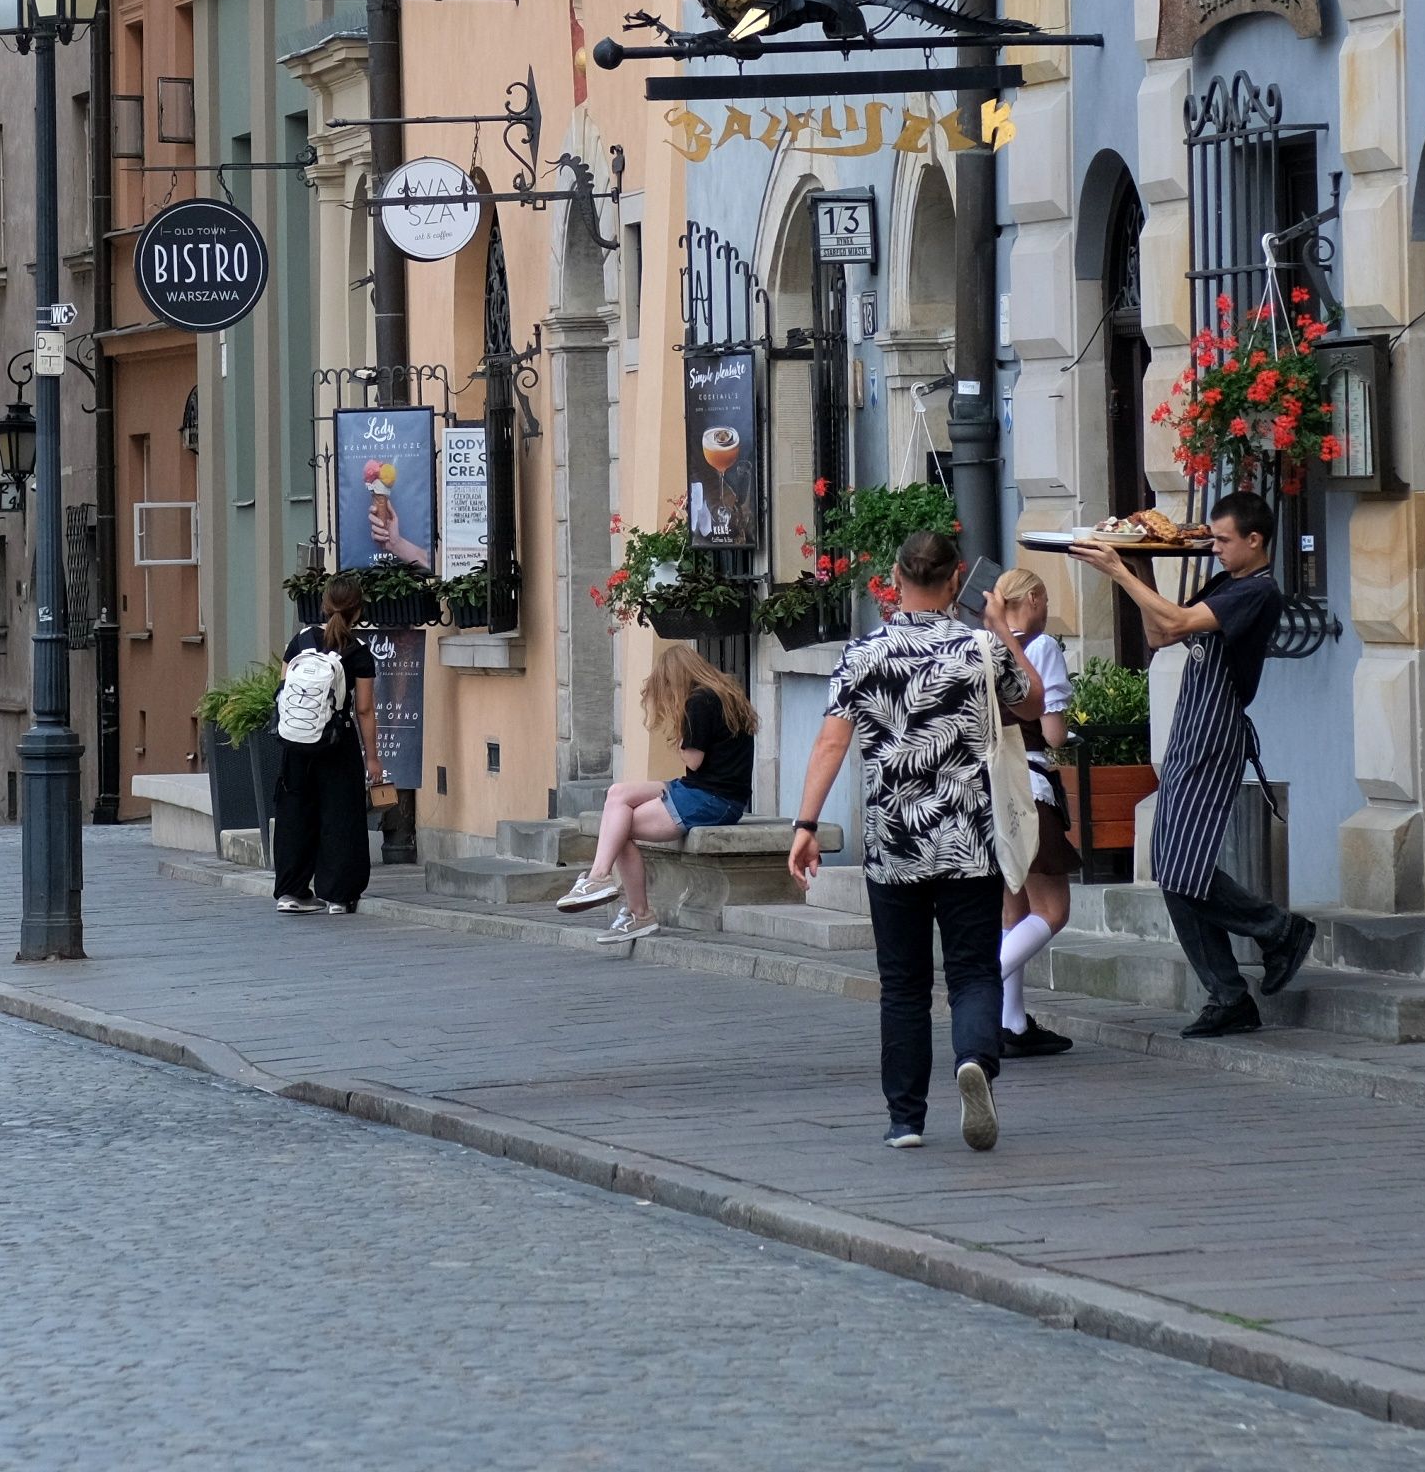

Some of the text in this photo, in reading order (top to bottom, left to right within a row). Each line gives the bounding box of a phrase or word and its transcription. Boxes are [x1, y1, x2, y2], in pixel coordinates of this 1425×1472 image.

[823, 206, 860, 235] 1/3
[174, 227, 226, 236] OLD TOWN
[154, 242, 248, 283] BISTRO
[166, 290, 240, 303] WARSZAWA
[52, 306, 68, 324] WC
[689, 361, 746, 389] Simple pleasure
[363, 416, 395, 442] Lody
[448, 439, 485, 450] LODY
[448, 452, 471, 463] ICE
[448, 465, 486, 477] CREA
[368, 634, 396, 659] Lody
[376, 701, 403, 710] MÓW
[387, 712, 419, 720] OKNO
